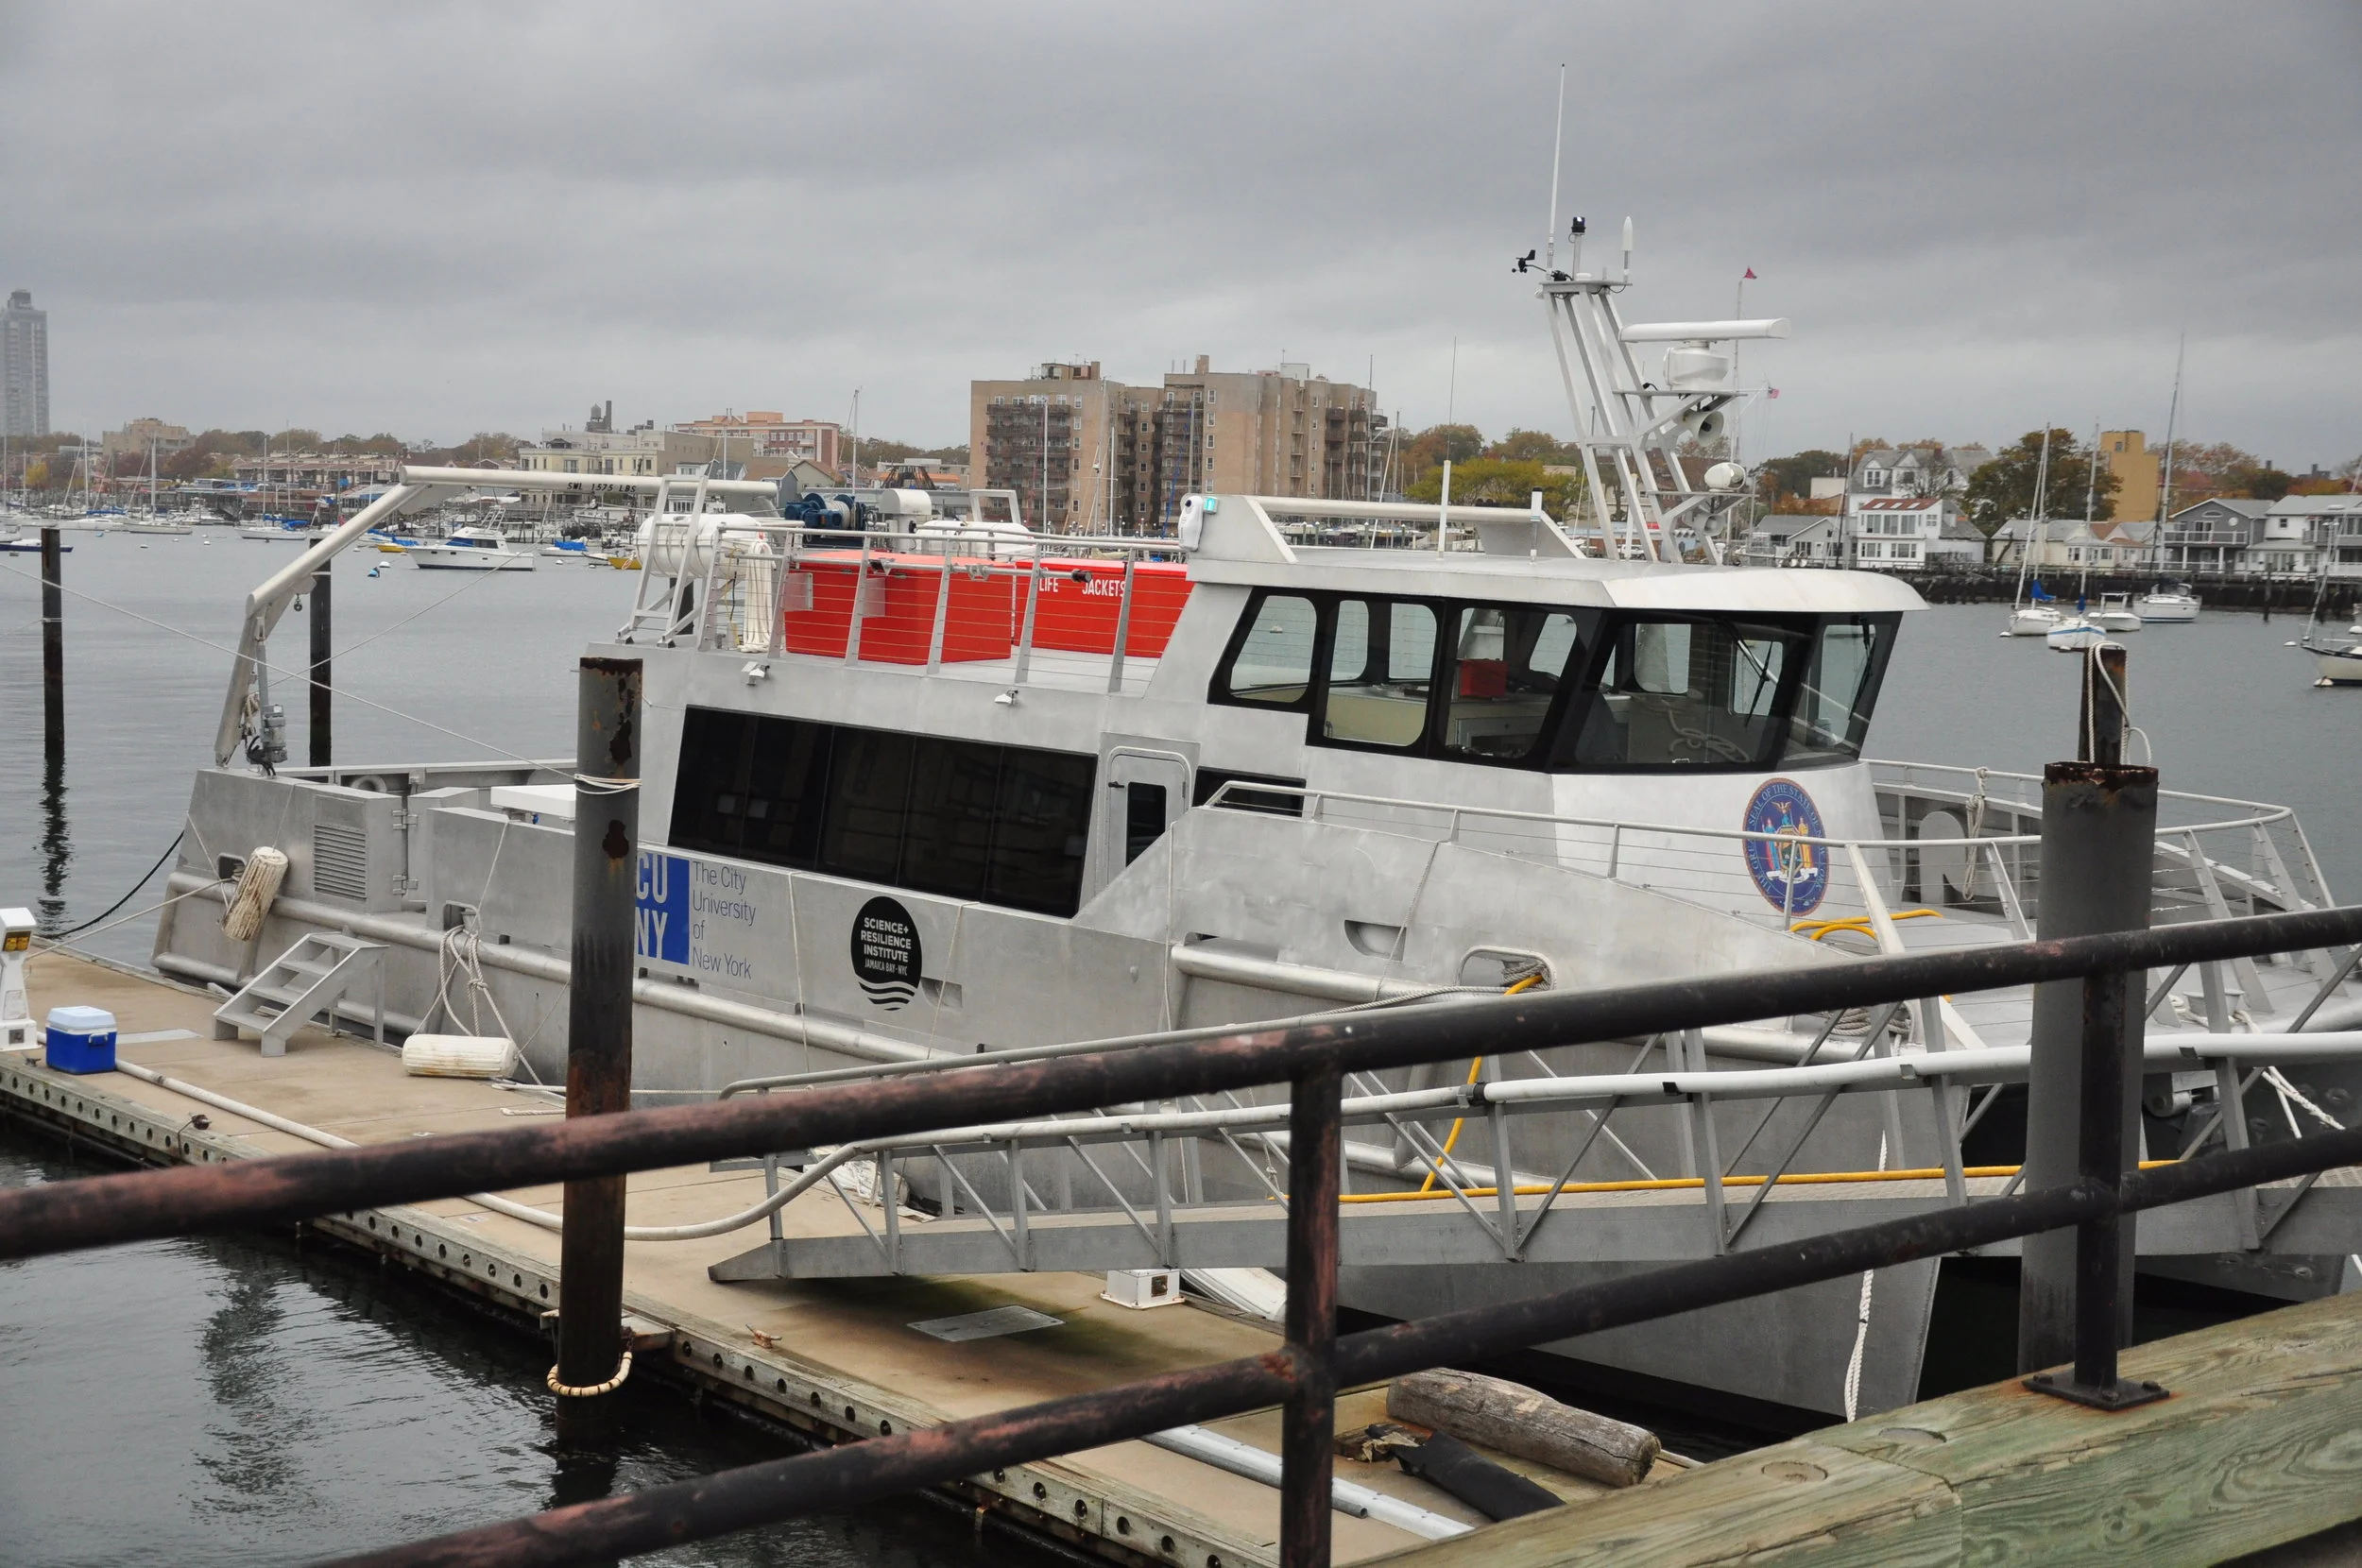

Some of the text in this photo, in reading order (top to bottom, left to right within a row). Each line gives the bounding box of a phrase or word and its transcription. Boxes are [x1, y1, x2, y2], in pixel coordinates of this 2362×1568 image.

[567, 482, 637, 493] SWL 1575 LBS
[1039, 577, 1125, 597] LIFE JACKETS
[1772, 784, 1788, 793] THE
[636, 853, 667, 904] CU
[693, 861, 746, 895] The City
[693, 890, 756, 926] University
[635, 907, 668, 959] NY
[693, 920, 705, 940] of
[861, 930, 912, 949] RESILIENCE
[693, 946, 751, 980] New York
[864, 945, 909, 963] INSTITUTE
